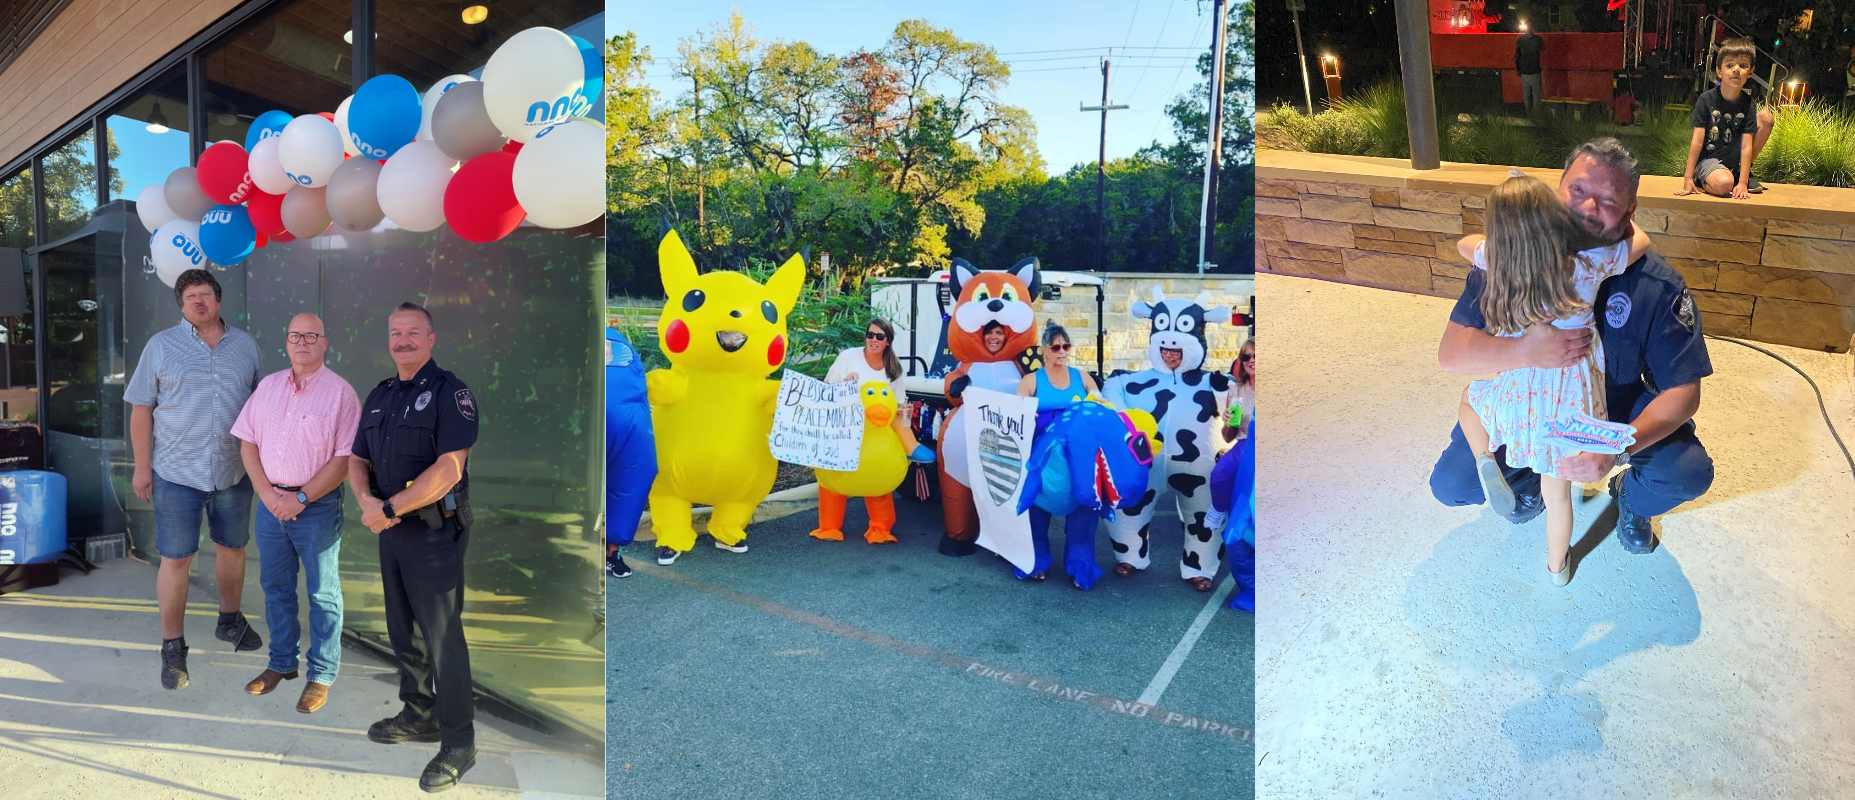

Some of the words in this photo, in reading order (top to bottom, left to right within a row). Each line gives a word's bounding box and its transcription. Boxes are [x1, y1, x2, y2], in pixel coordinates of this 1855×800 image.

[526, 86, 582, 123] nno
[351, 132, 388, 158] nno
[229, 171, 254, 203] nno
[201, 211, 232, 226] nno
[172, 234, 203, 266] nno
[792, 401, 863, 428] PEACEMAKERS
[978, 404, 1006, 432] Thank
[1001, 414, 1025, 441] you!
[805, 429, 820, 439] shall
[823, 431, 831, 440] be
[832, 428, 852, 440] called
[1568, 423, 1618, 440] NNO
[774, 434, 807, 449] Children
[811, 442, 819, 459] of
[823, 441, 840, 458] God
[1, 502, 18, 536] nno
[965, 663, 1015, 681] FIRE
[1027, 680, 1101, 701] LANE
[1110, 700, 1150, 717] NO
